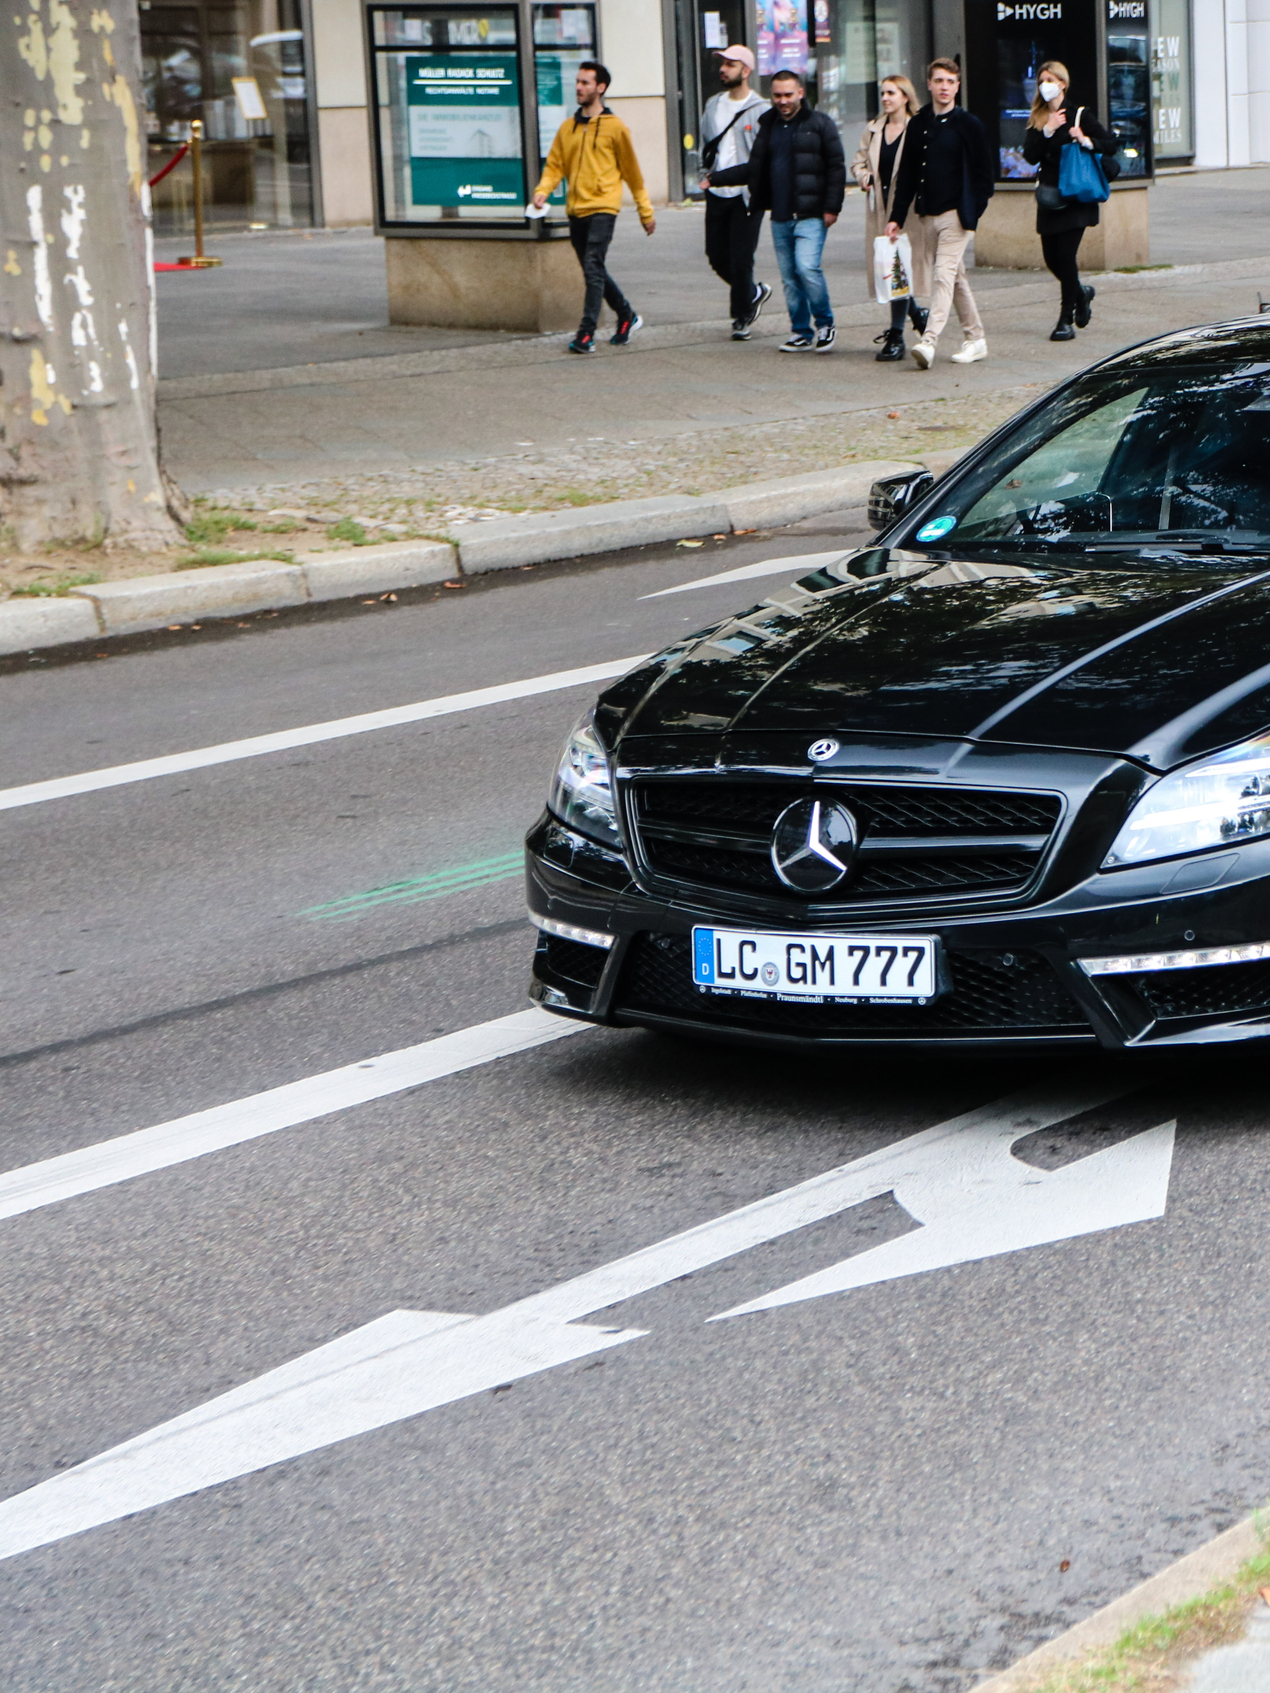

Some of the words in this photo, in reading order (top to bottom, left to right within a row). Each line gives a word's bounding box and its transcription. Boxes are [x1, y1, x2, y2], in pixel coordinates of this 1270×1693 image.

[1015, 3, 1062, 20] HYGH
[1118, 2, 1145, 18] HYGH
[1156, 36, 1180, 58] EW
[1158, 107, 1181, 129] EW
[702, 963, 710, 976] D
[716, 938, 758, 980] LC
[786, 943, 835, 986] GM
[848, 945, 926, 987] 777
[777, 993, 824, 1003] Praunsmändtl
